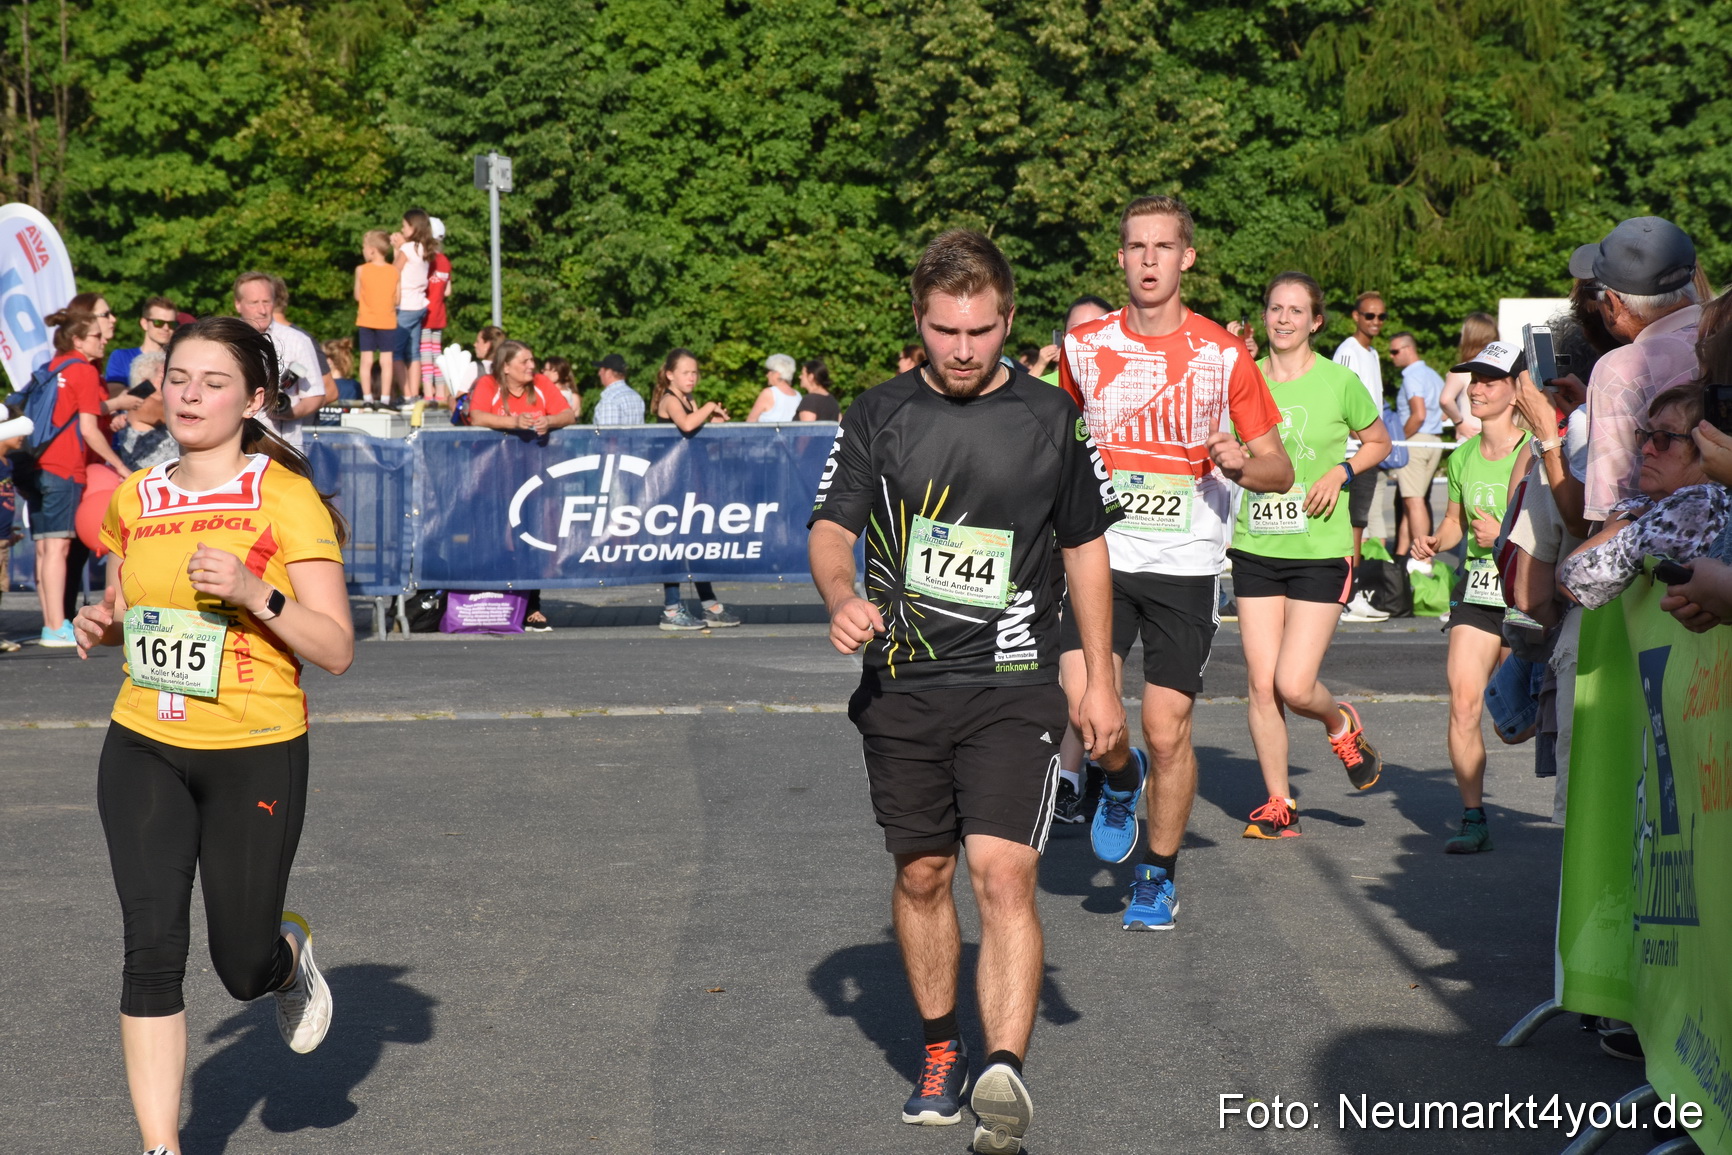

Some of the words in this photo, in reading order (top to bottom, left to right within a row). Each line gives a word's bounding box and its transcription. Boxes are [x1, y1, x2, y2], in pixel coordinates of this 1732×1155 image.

[1121, 492, 1181, 516] 2222
[1252, 502, 1298, 520] 2418
[558, 492, 780, 538] Fischer
[134, 521, 185, 541] MAX
[190, 514, 257, 533] BÖGL
[924, 534, 963, 548] firmenlauf
[578, 540, 764, 564] AUTOMOBILE
[986, 550, 1005, 558] 2019
[920, 547, 995, 585] 1744
[925, 575, 949, 587] Keindl
[950, 581, 984, 593] Andreas
[137, 621, 174, 634] firmenlauf
[196, 634, 217, 642] 2019
[136, 636, 206, 671] 1615
[150, 667, 169, 677] Koller
[171, 670, 189, 680] Katja
[995, 661, 1039, 673] drinknow.de
[160, 676, 185, 686] Bauservice
